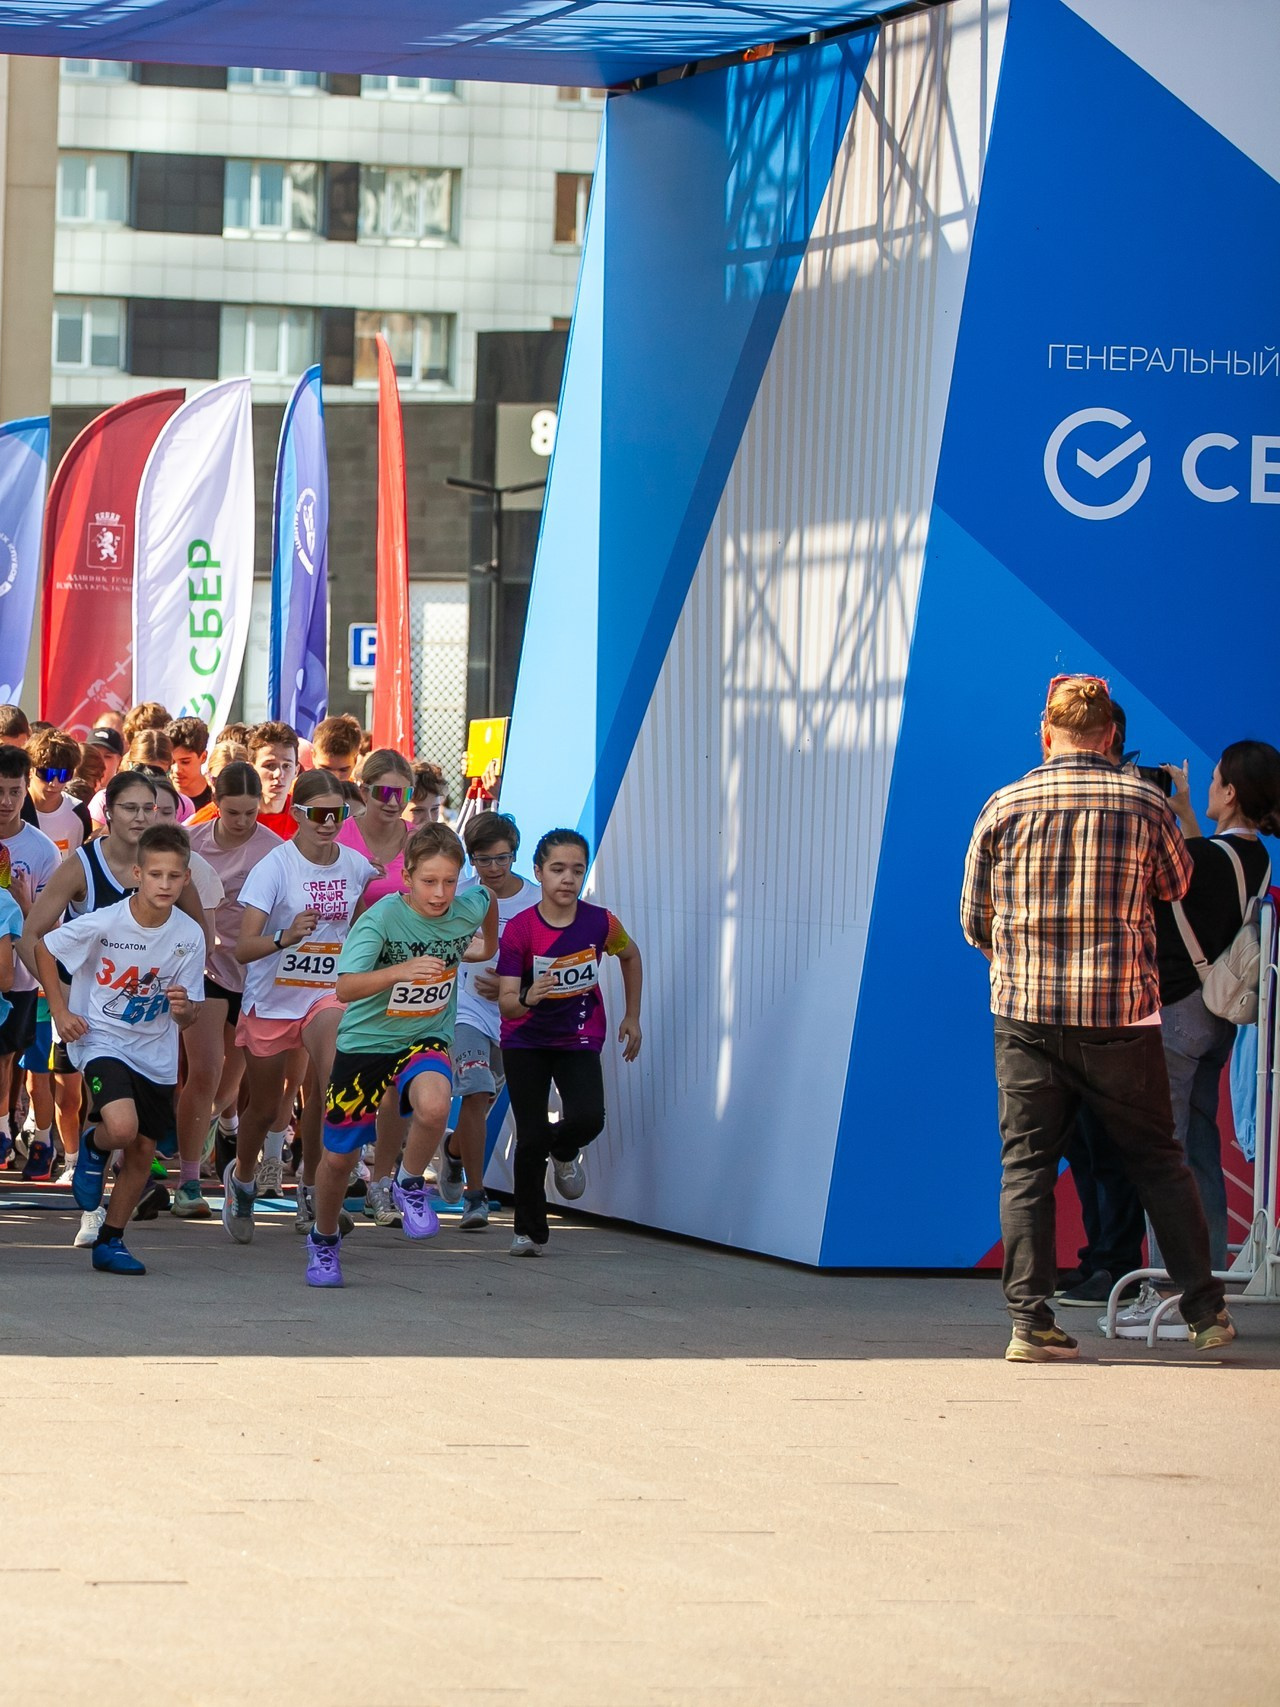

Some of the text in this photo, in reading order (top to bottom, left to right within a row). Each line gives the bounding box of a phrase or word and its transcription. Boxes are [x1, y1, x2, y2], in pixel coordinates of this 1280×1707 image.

[1048, 343, 1280, 377] ГЕНЕРАЛЬНЫЙ
[187, 539, 222, 676] СБЕР
[109, 942, 147, 951] РОСАТОМ
[282, 953, 335, 975] 3419
[538, 963, 595, 986] 104
[392, 982, 452, 1005] 3280
